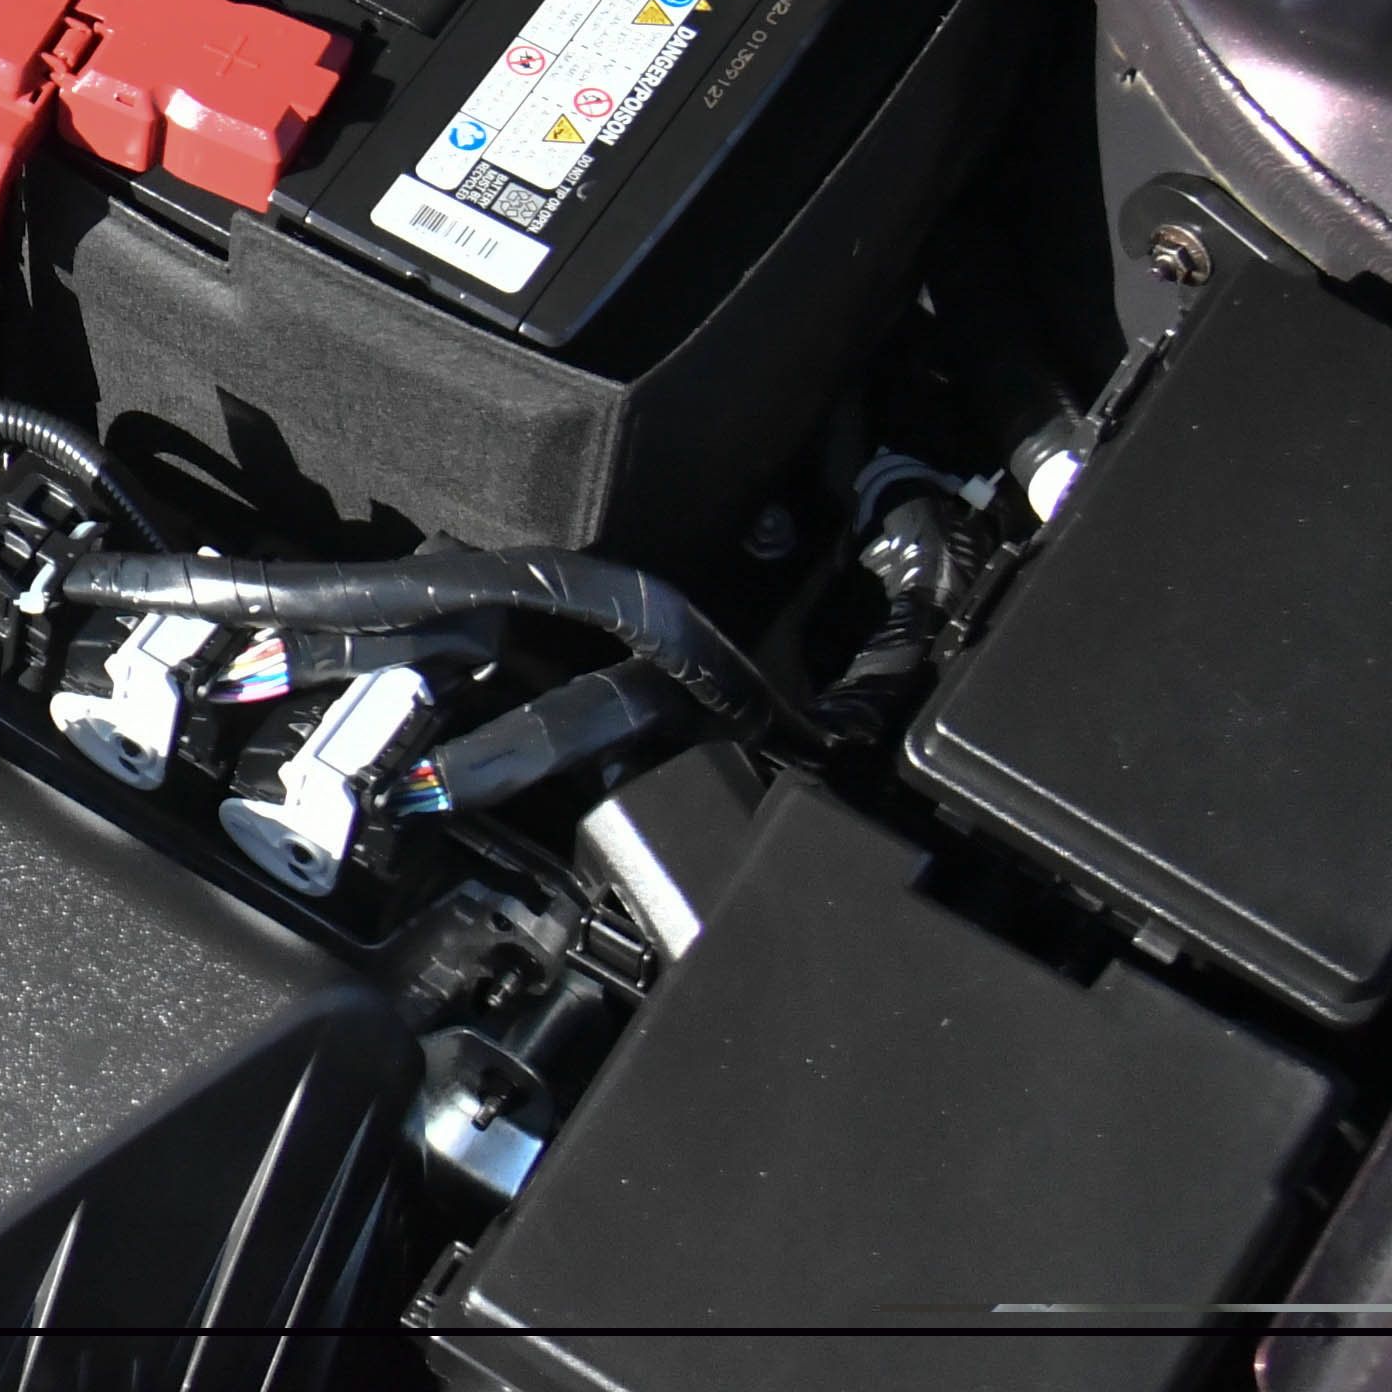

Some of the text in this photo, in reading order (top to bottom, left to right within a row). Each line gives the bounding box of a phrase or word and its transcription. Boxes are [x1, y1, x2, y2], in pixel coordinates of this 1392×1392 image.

[595, 22, 696, 145] DANGER/POISON
[575, 152, 593, 168] DO
[456, 162, 490, 200] RECYCLED
[466, 166, 498, 203] MUST BE
[562, 164, 584, 185] NOT
[476, 173, 508, 208] BATTERY
[556, 181, 571, 199] TIP
[544, 198, 560, 211] OR
